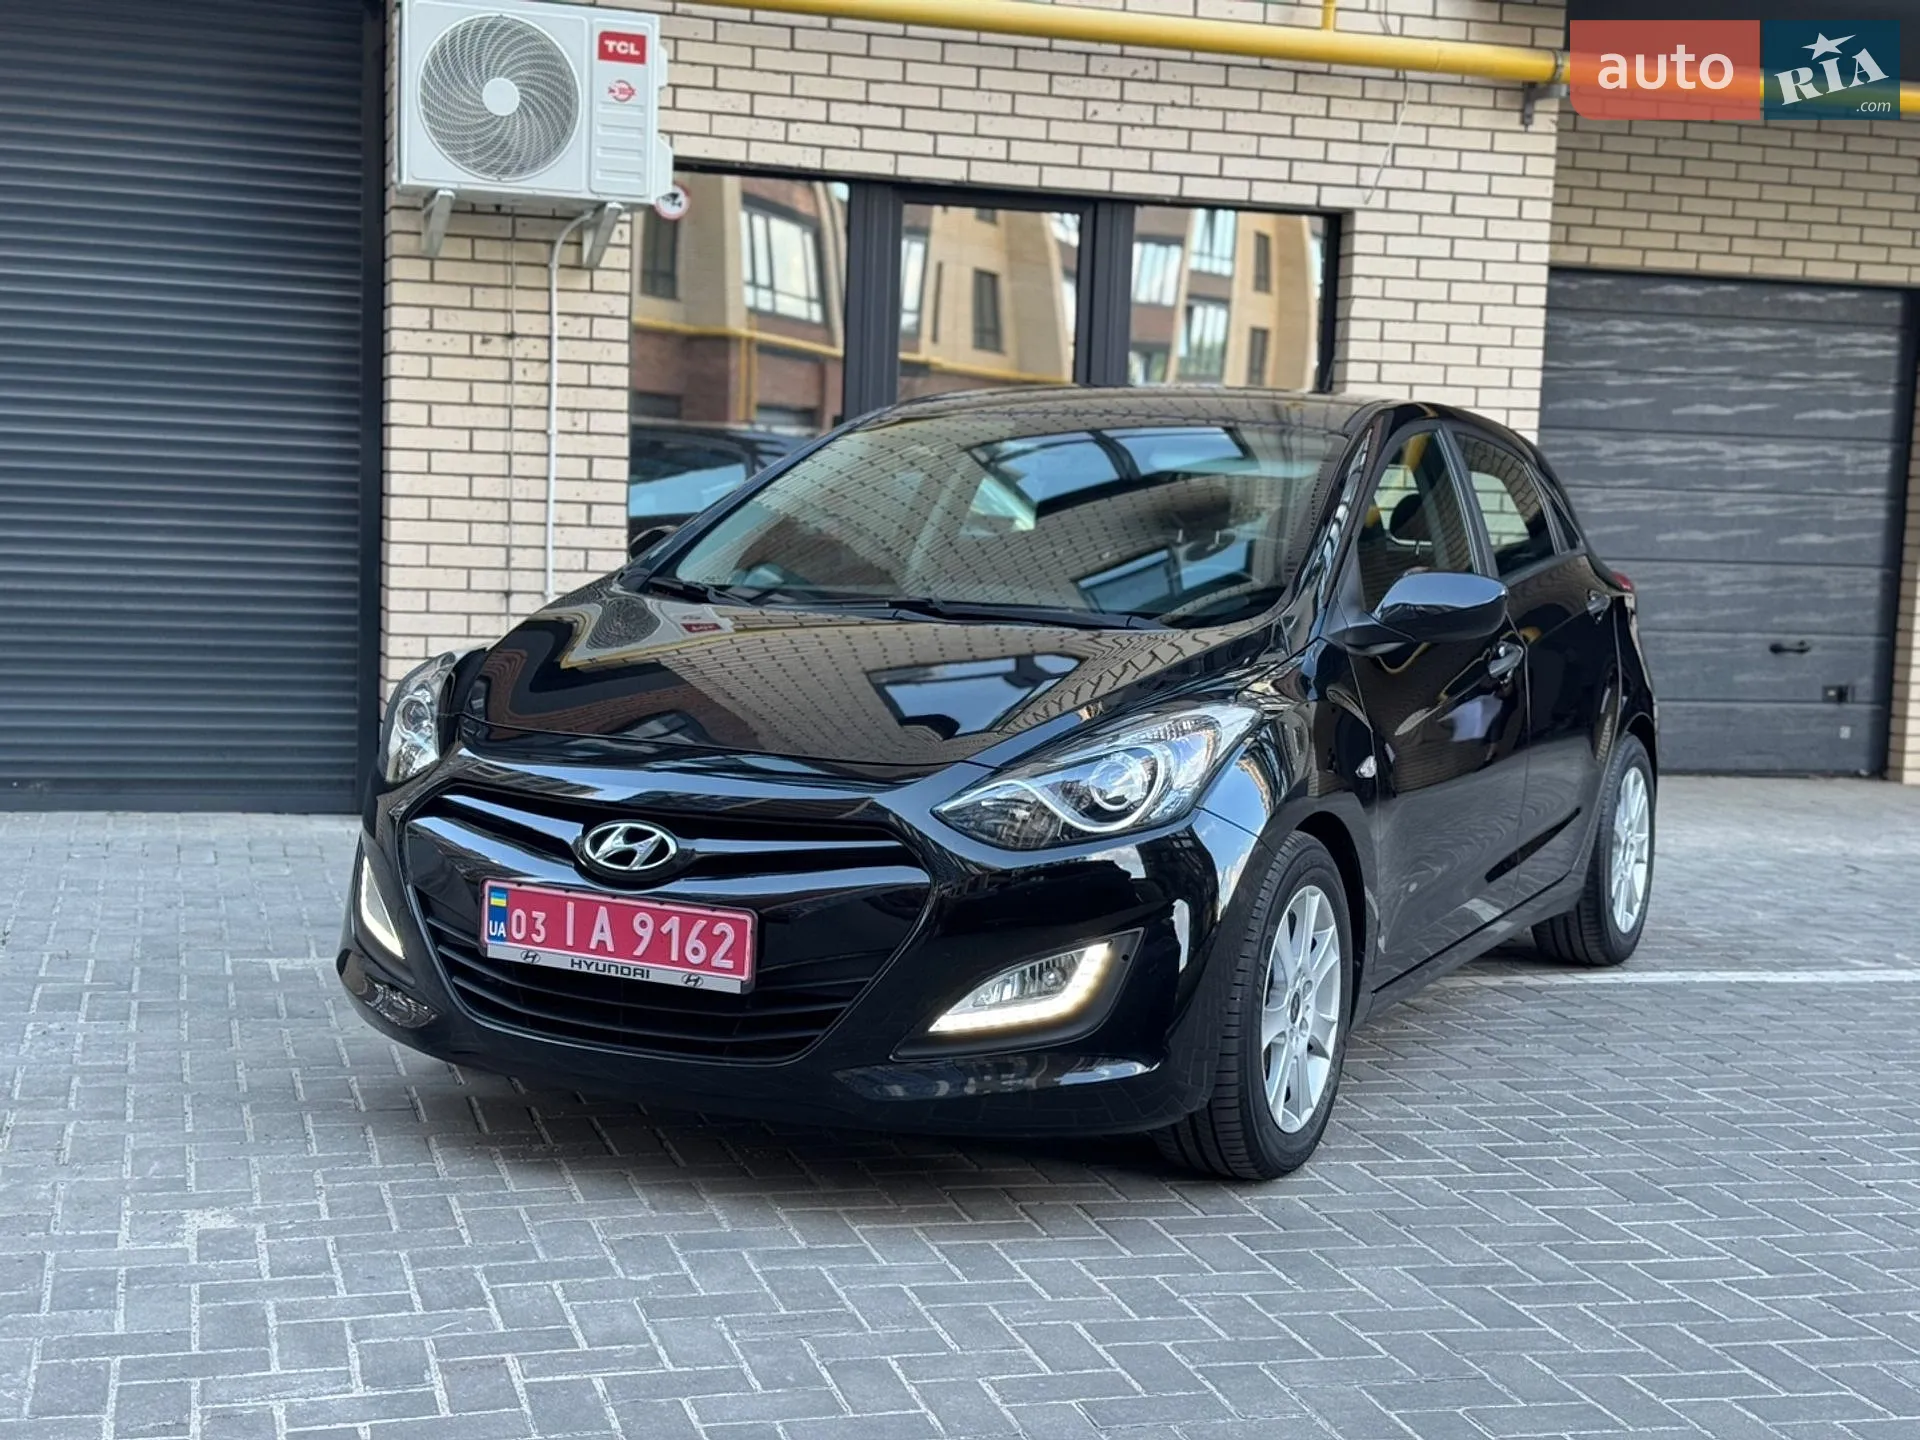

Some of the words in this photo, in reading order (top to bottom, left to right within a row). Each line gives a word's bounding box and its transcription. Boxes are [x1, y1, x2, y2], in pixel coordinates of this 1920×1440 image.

[604, 39, 641, 56] TCL
[489, 919, 507, 938] UA
[511, 908, 547, 943] 03
[565, 901, 615, 952] IA
[632, 912, 735, 970] 9162
[570, 957, 651, 980] HYUNDAI
